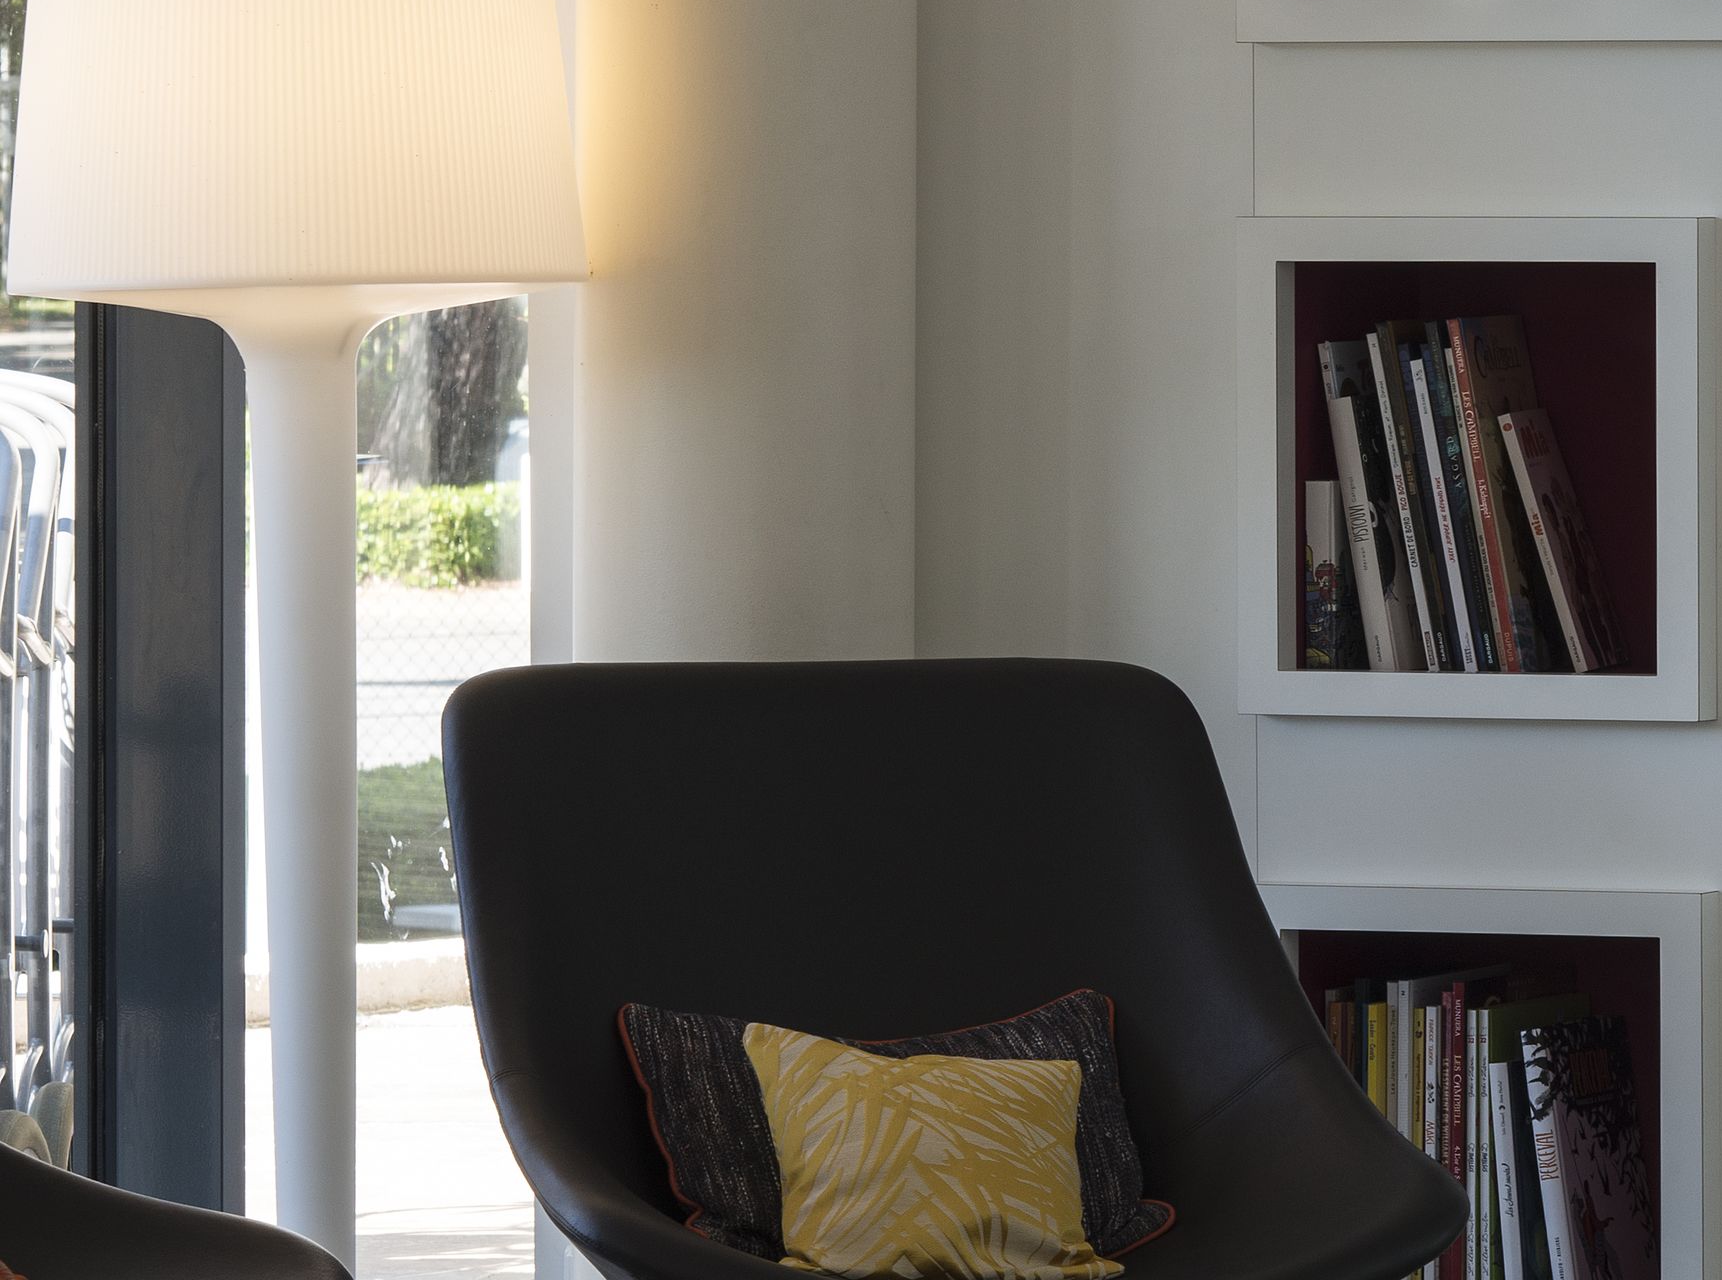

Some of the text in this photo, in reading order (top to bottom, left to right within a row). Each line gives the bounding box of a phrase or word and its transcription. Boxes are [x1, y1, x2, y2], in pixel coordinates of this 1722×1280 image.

[1452, 336, 1464, 374] MUNUERA
[1464, 409, 1481, 462] CAMPBELL
[1447, 435, 1463, 489] ASGARD
[1396, 474, 1405, 496] BOGUE
[1349, 504, 1370, 543] PISTOUVI
[1443, 522, 1453, 546] JUMPER
[1408, 544, 1419, 568] CARNET
[1438, 632, 1448, 662] DARGAUD
[1484, 633, 1493, 664] DARGAUD
[1504, 632, 1514, 662] DUPUIS
[1453, 1074, 1461, 1126] CAMPBELL
[1536, 1129, 1560, 1181] PERCEVAL
